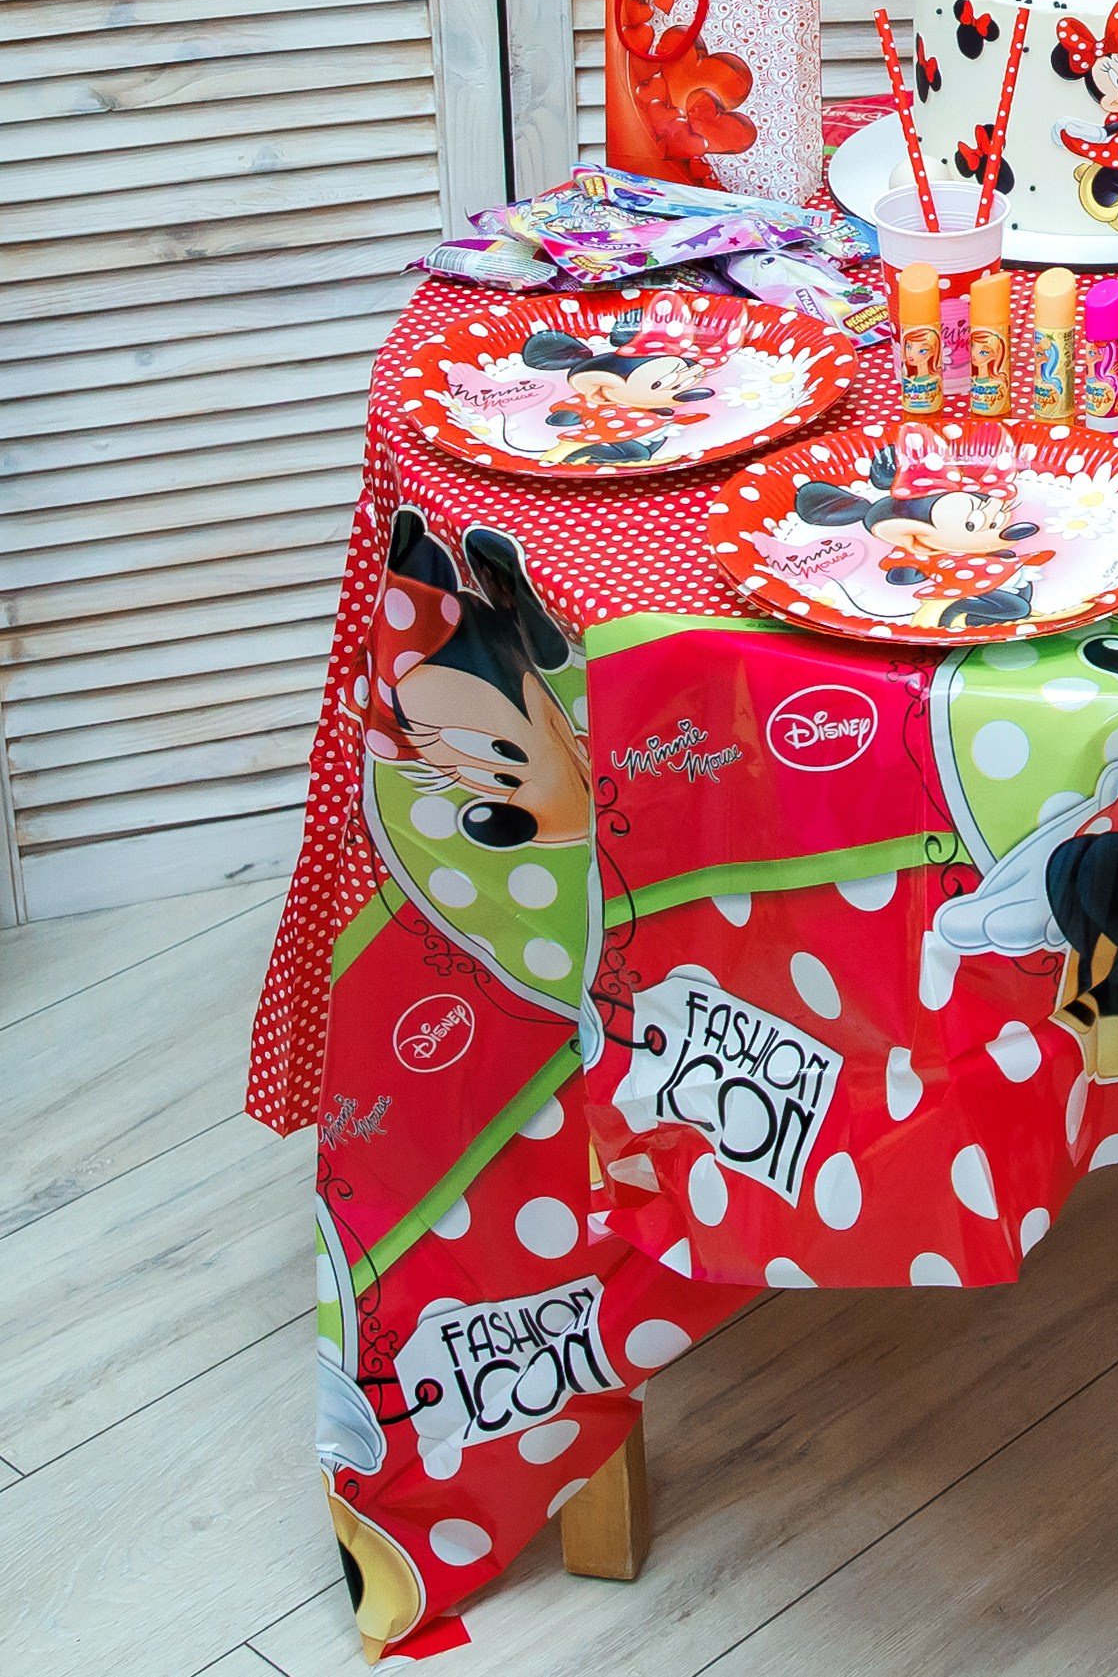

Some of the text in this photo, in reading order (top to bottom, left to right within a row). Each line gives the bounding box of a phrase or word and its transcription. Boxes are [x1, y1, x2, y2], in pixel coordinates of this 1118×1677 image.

[449, 380, 545, 407] Minnie
[765, 539, 852, 576] Minnie
[611, 719, 708, 781] Minnie
[667, 744, 743, 783] Mouse
[686, 991, 828, 1107] FASHION
[319, 1093, 358, 1151] Minnie
[346, 1095, 393, 1143] Mouse
[656, 1036, 816, 1190] ICON
[440, 1287, 598, 1366] FASHION
[455, 1330, 612, 1440] ICON
